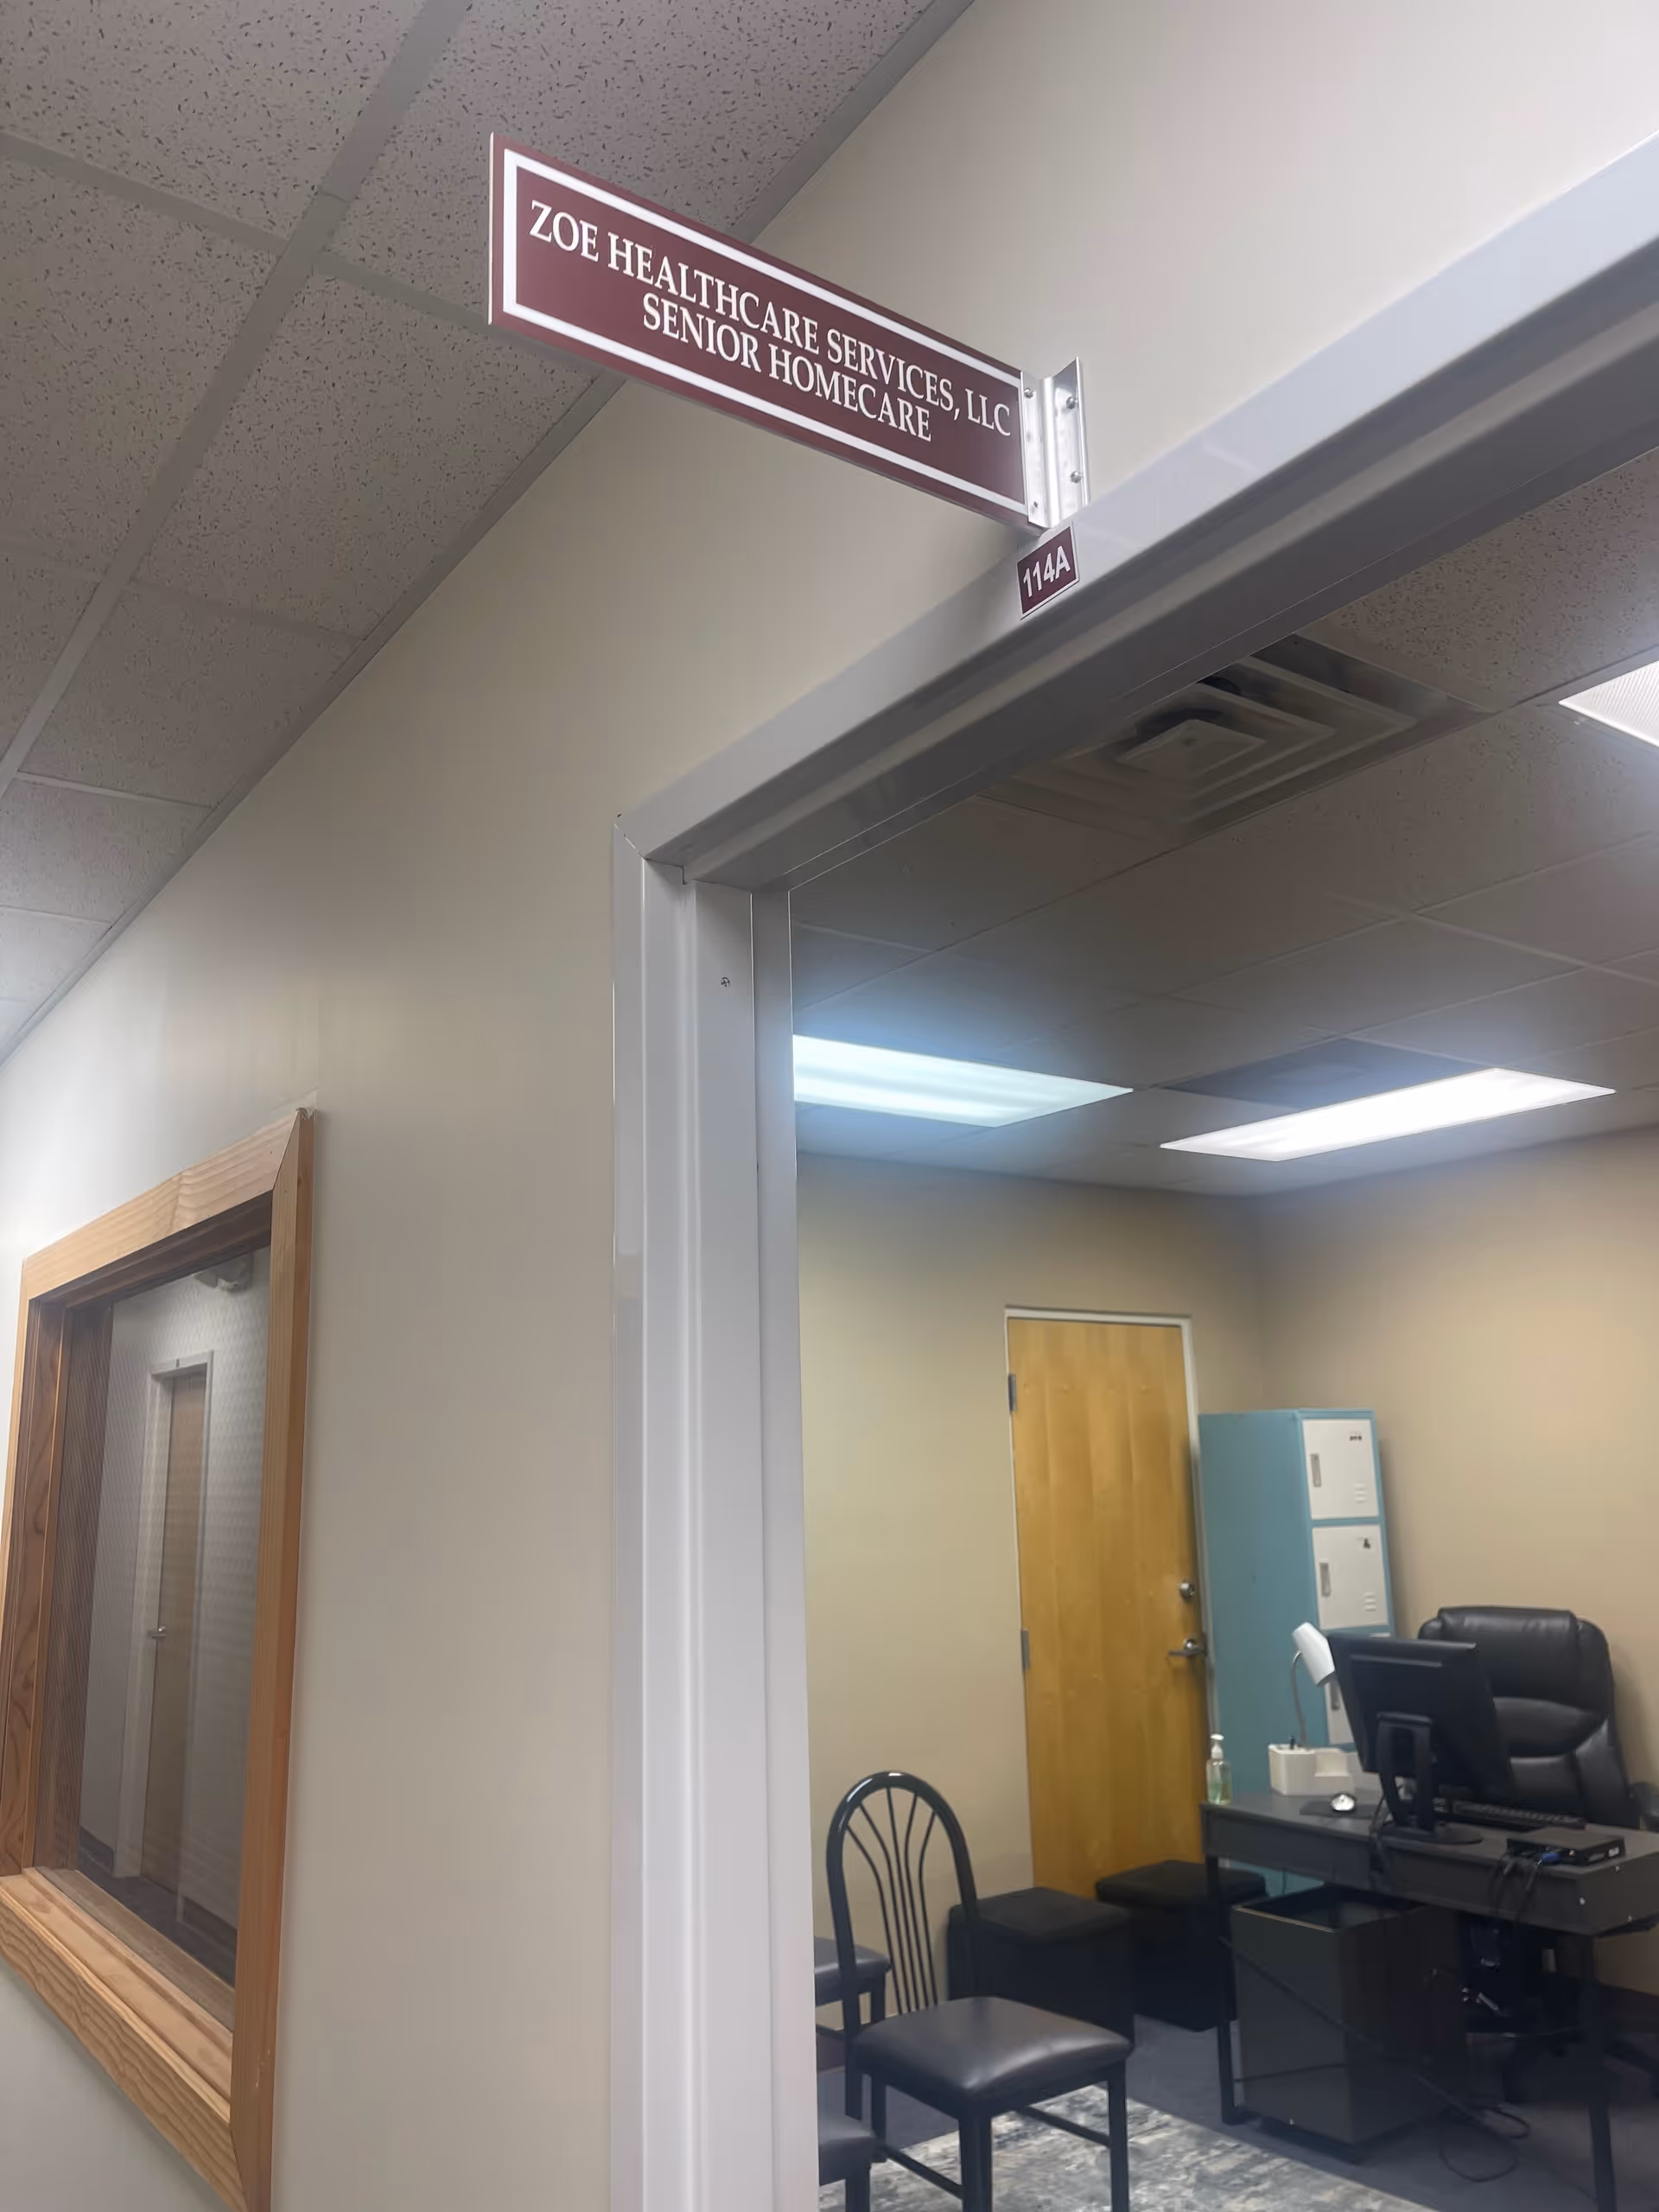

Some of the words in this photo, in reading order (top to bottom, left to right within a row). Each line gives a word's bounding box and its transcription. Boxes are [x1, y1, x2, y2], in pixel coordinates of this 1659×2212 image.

[529, 199, 600, 262] ZOE
[607, 232, 820, 355] HEALTHCARE
[827, 328, 960, 422] SERVICES,
[964, 388, 1011, 436] LLC
[643, 292, 762, 373] SENIOR
[768, 343, 931, 442] HOMECARE
[1022, 545, 1071, 598] 114A
